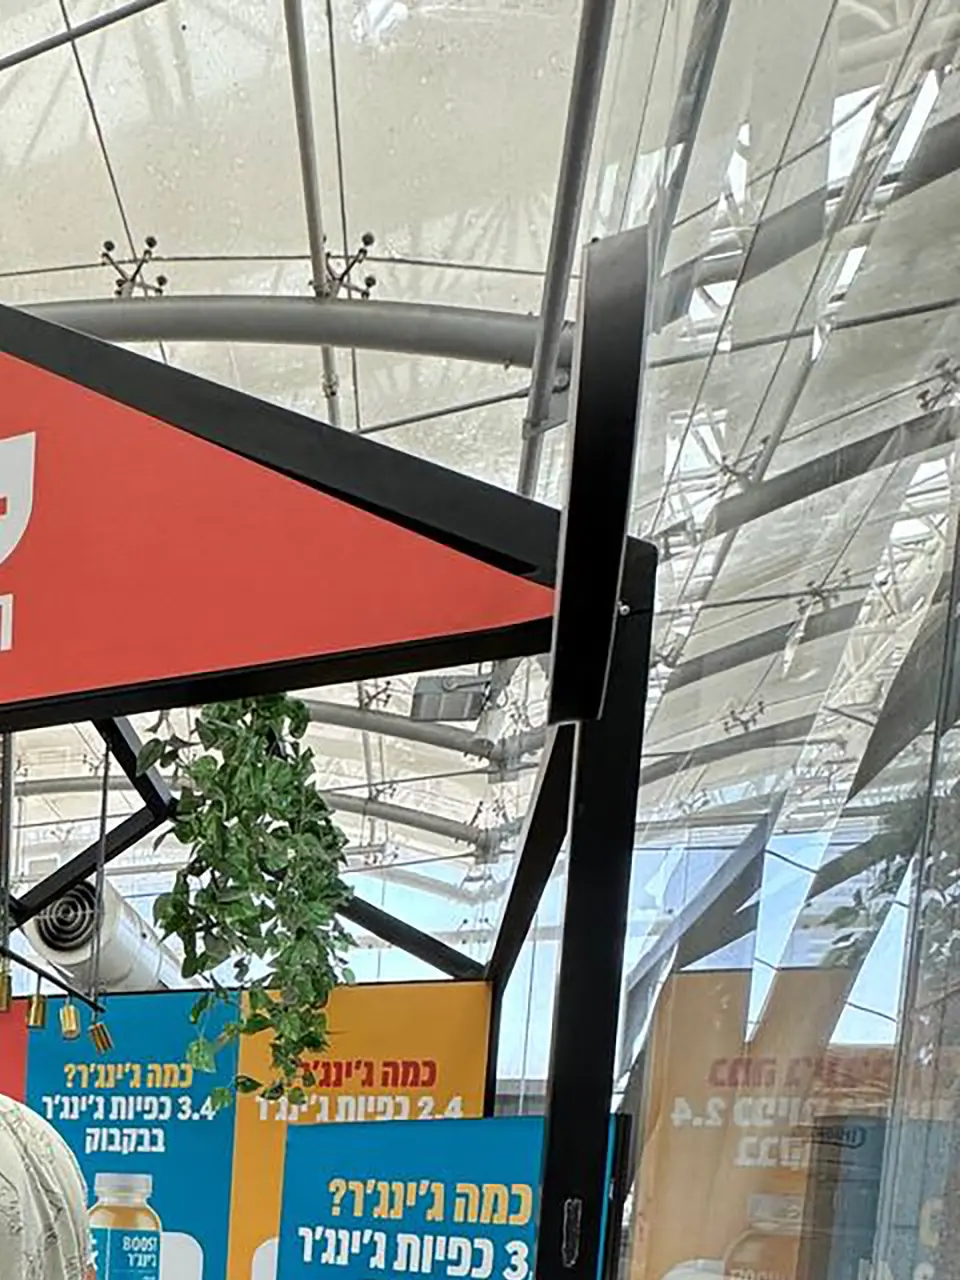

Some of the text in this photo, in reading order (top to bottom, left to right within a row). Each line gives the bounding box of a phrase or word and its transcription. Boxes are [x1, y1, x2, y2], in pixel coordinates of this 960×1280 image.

[63, 1062, 194, 1089] כמה ג'ינג'ר?
[301, 1059, 437, 1088] כמה ג'ינג'
[41, 1095, 217, 1121] 3.4 כפיות ג'ינג'ר
[335, 1094, 411, 1122] כפיות
[85, 1127, 166, 1155] בבקבוק
[328, 1177, 533, 1226] כמה ג'ינג'ר?
[297, 1225, 388, 1270] ג'ינג'ר
[392, 1232, 494, 1280] כפיות
